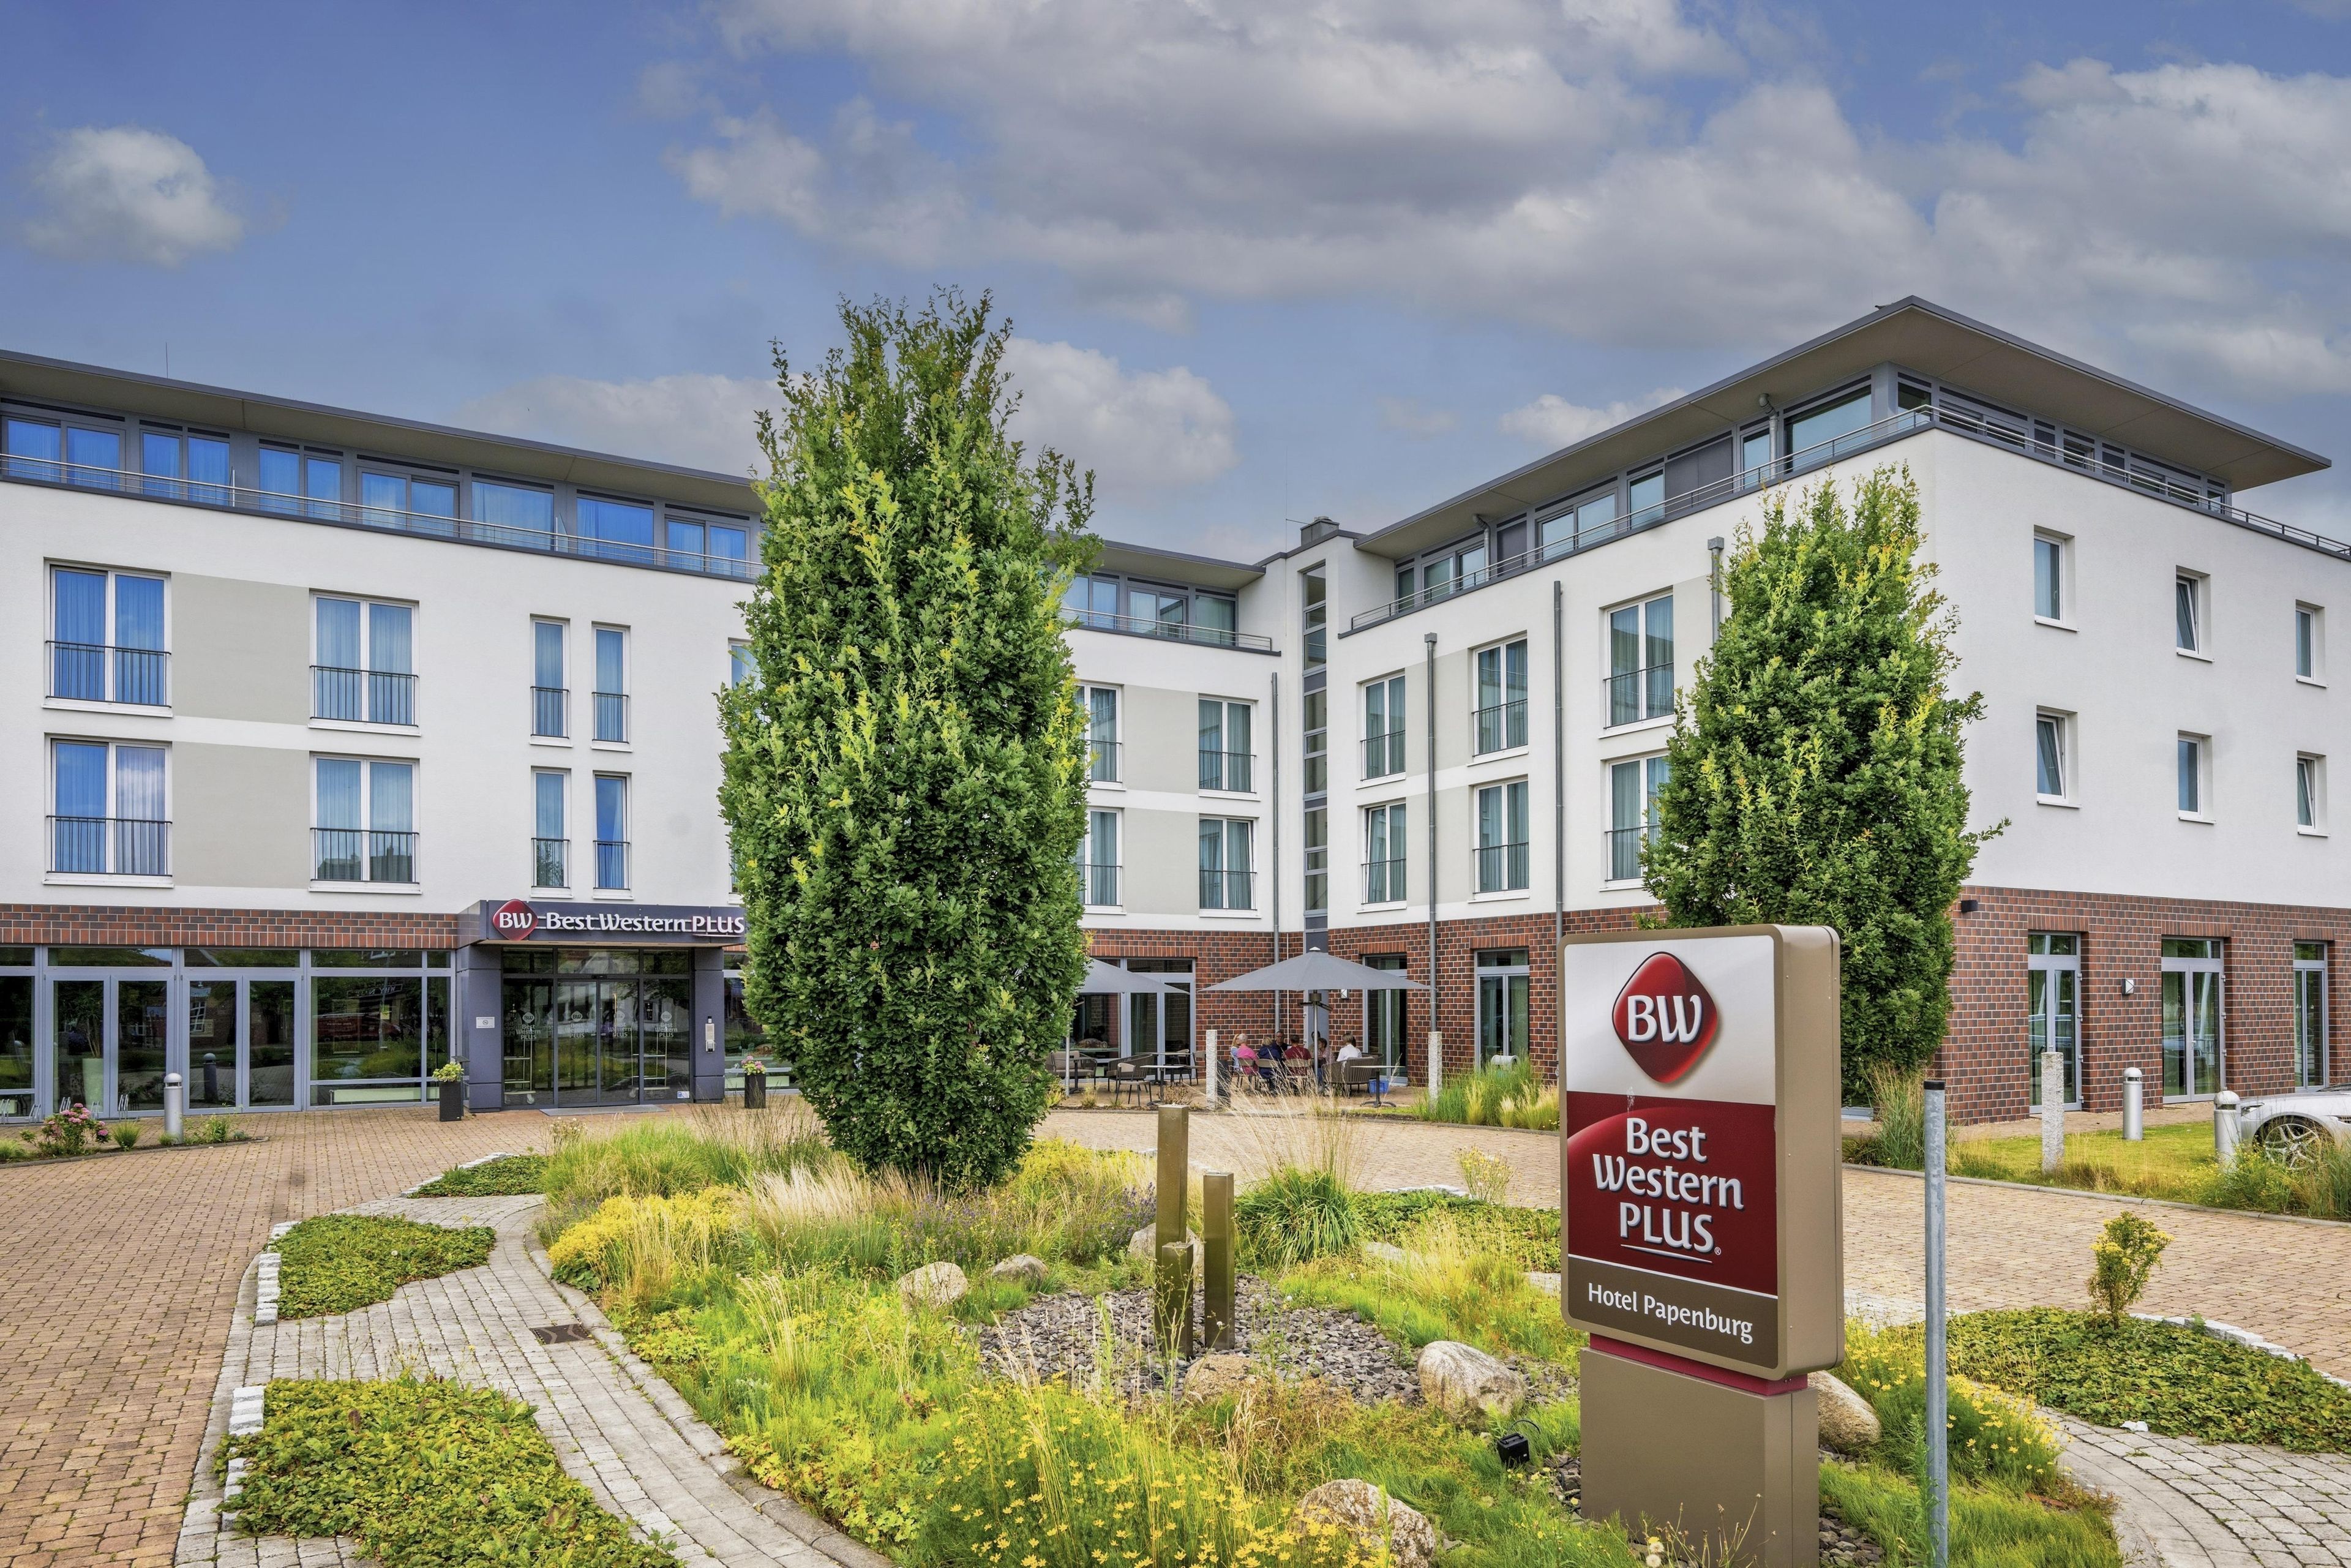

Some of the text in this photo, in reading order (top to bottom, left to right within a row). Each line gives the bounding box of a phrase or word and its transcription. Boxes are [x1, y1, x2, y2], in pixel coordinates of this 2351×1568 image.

[499, 912, 745, 933] BW Best Western PLUS
[1627, 994, 1704, 1043] BW
[1626, 1117, 1708, 1161] Best
[1592, 1153, 1745, 1210] Western
[1588, 1282, 1753, 1345] Hotel Papenburg
